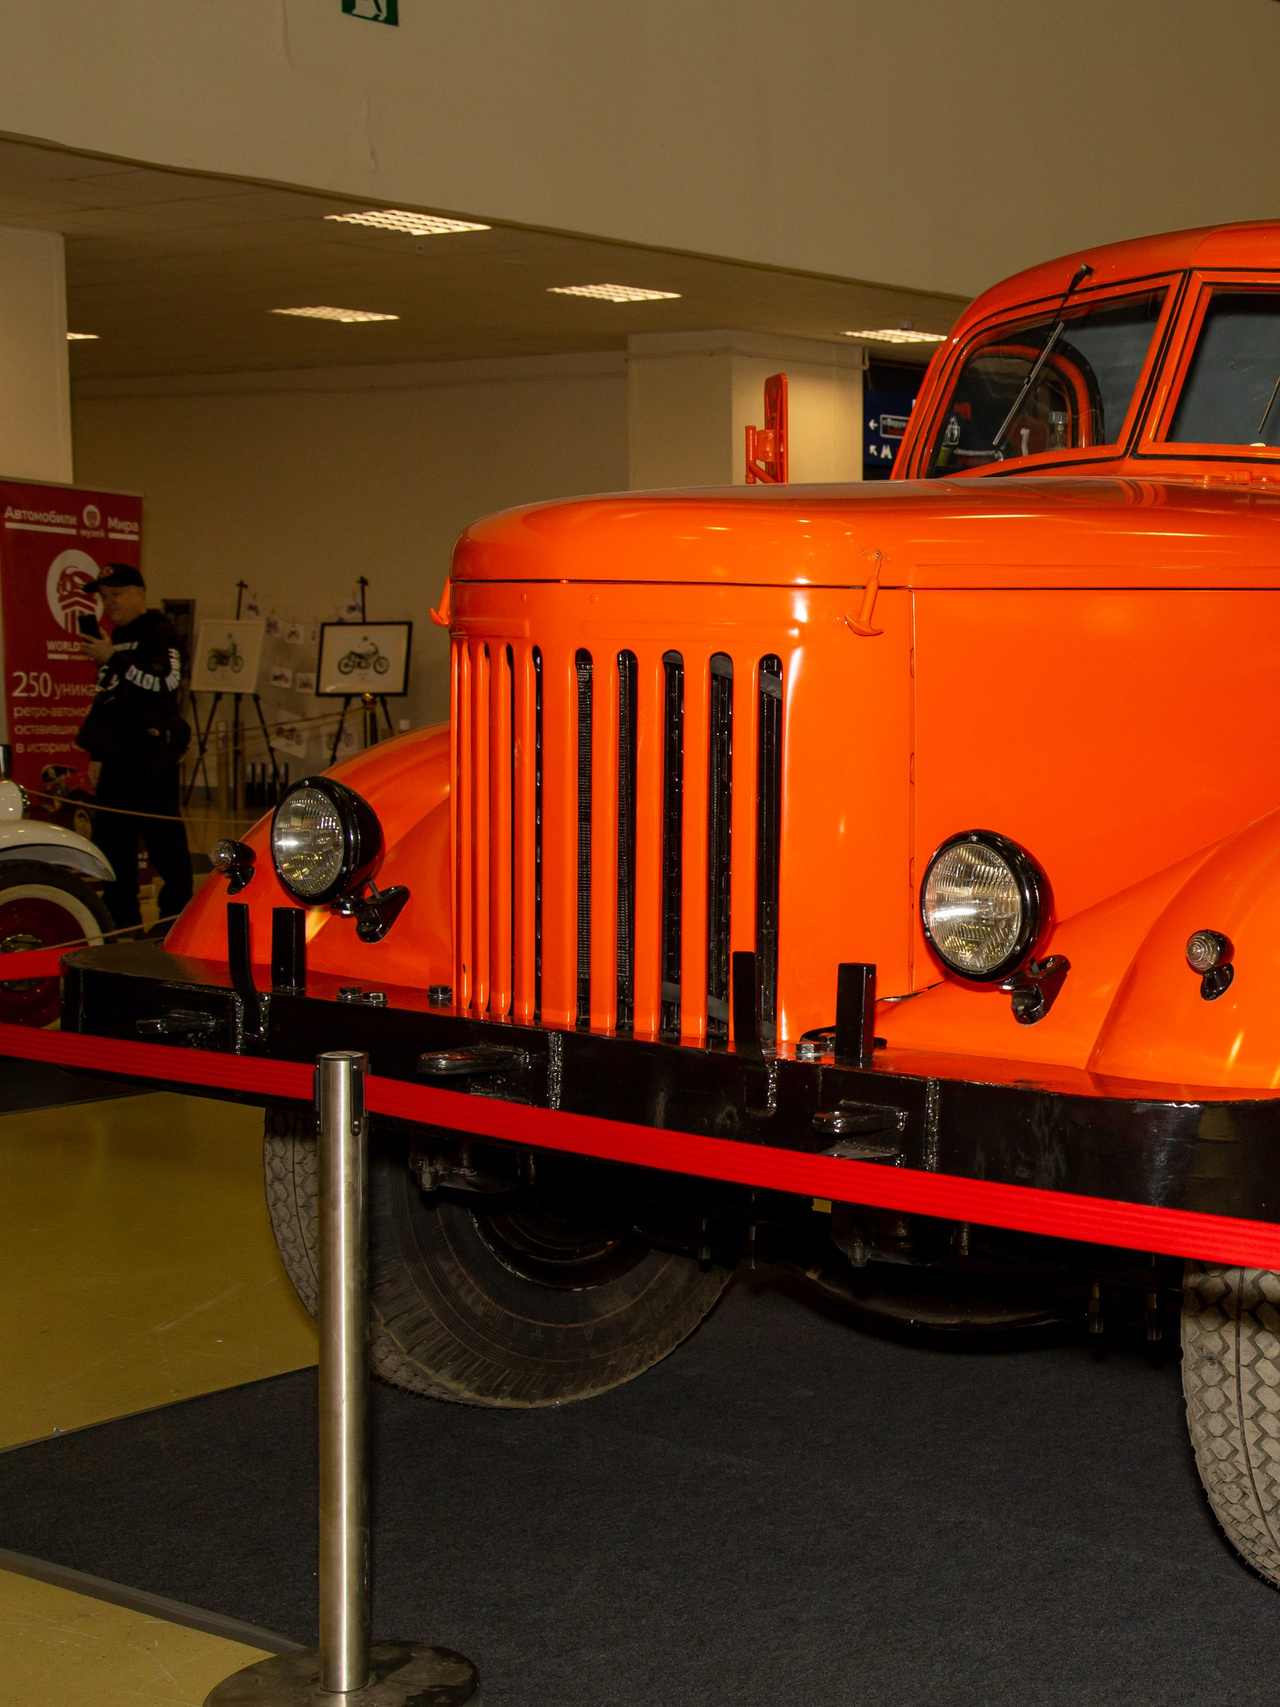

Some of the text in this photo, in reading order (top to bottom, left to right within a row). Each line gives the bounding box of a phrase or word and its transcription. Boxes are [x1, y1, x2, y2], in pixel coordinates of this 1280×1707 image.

[4, 505, 139, 534] Автомобили Мира
[46, 640, 81, 652] WORLD
[11, 670, 98, 700] 250 уника
